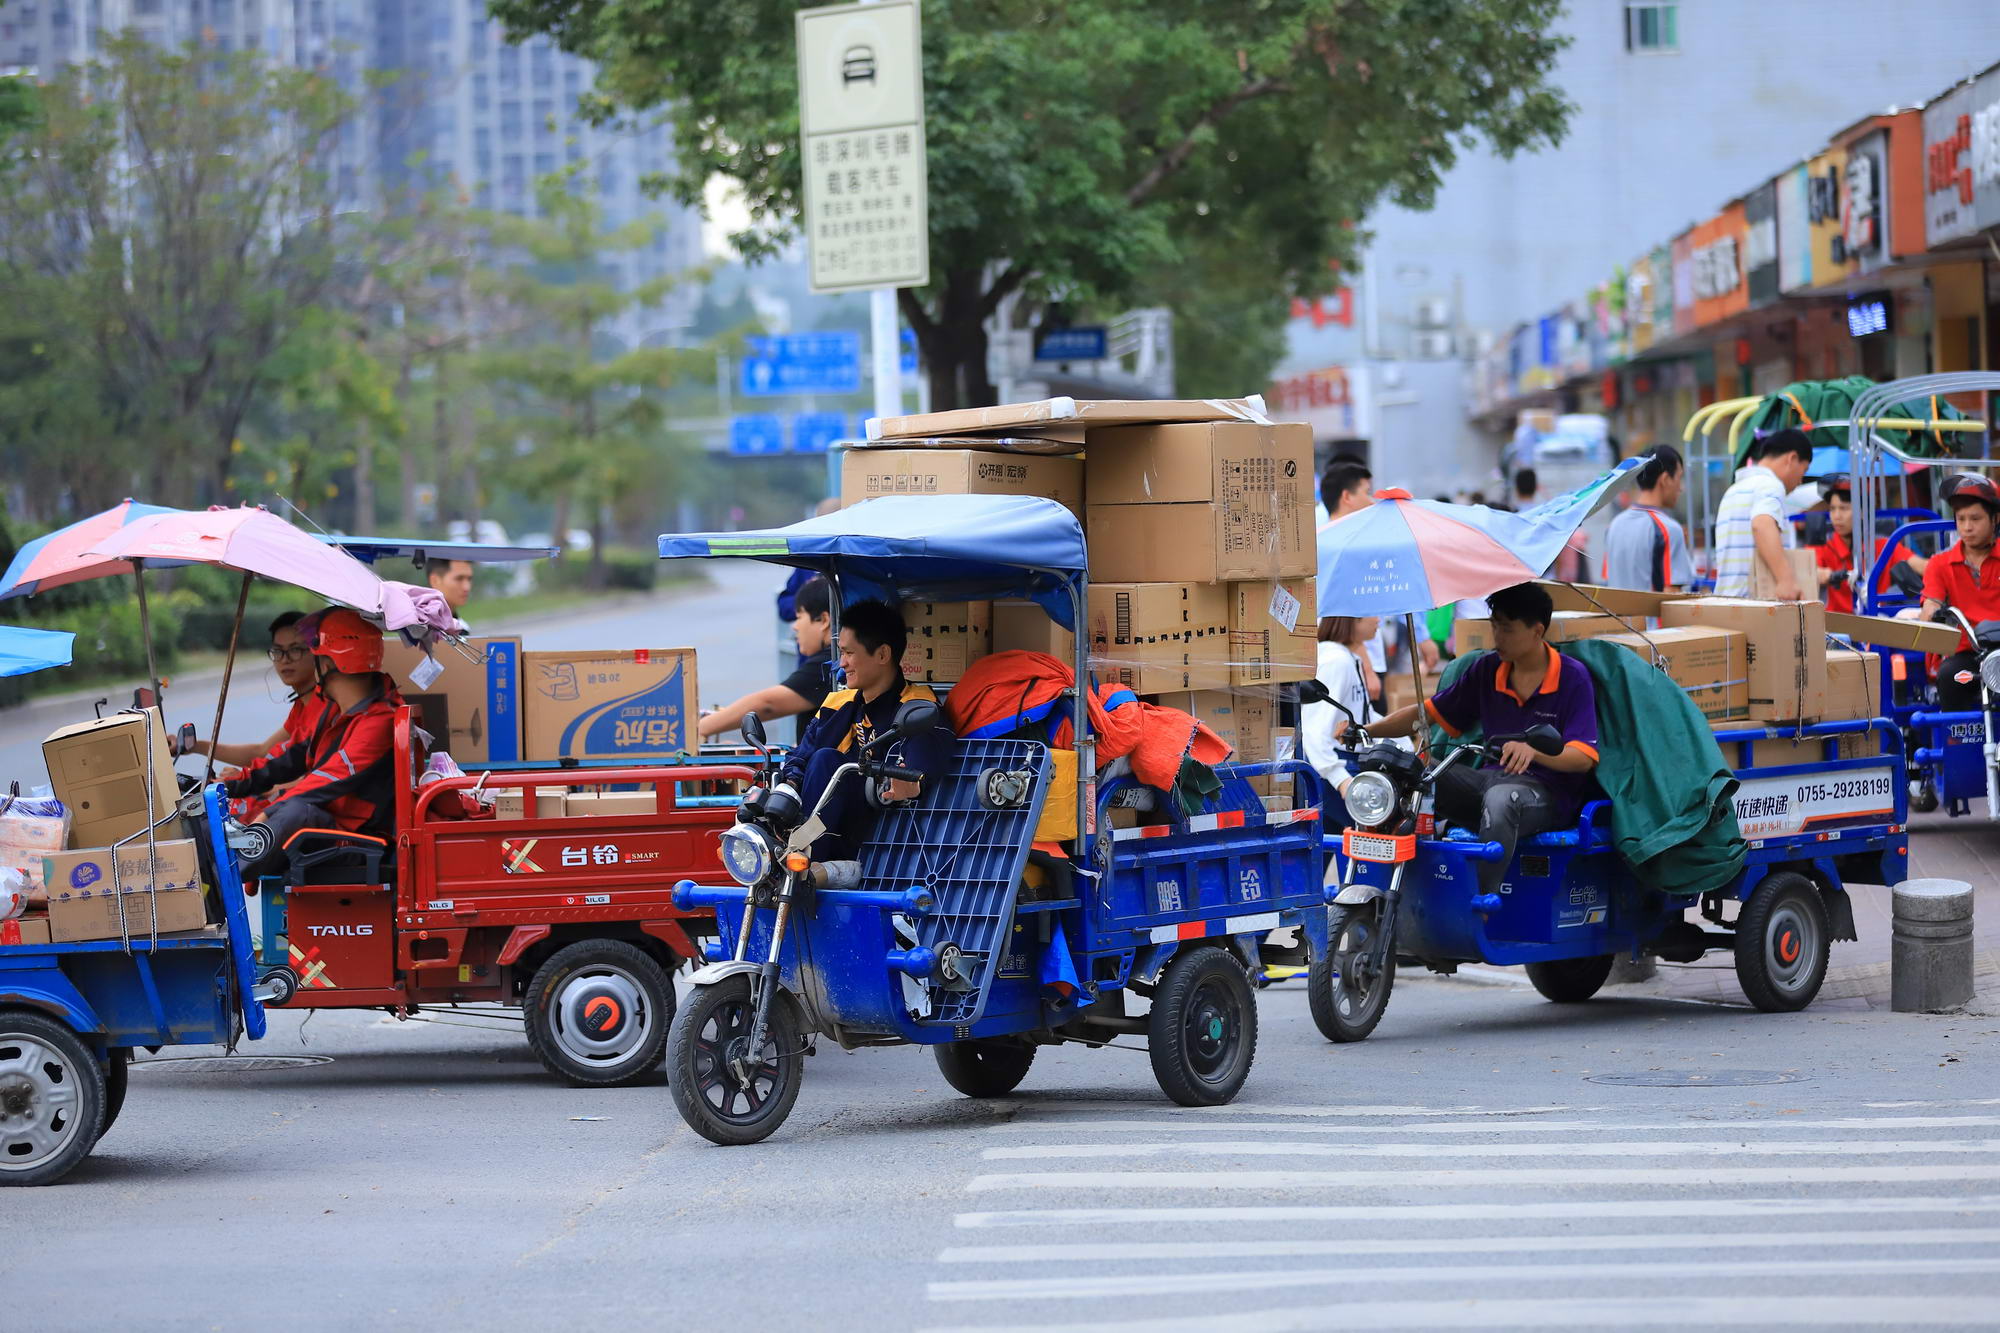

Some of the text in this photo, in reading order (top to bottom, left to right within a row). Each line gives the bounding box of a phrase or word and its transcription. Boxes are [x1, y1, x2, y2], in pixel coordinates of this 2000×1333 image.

[614, 719, 680, 746] 洁成
[1797, 777, 1890, 803] 0755-29238199
[1736, 793, 1789, 820] 优速快递
[561, 844, 620, 867] 台铃
[631, 852, 660, 860] SMART
[307, 924, 374, 937] TAILG
